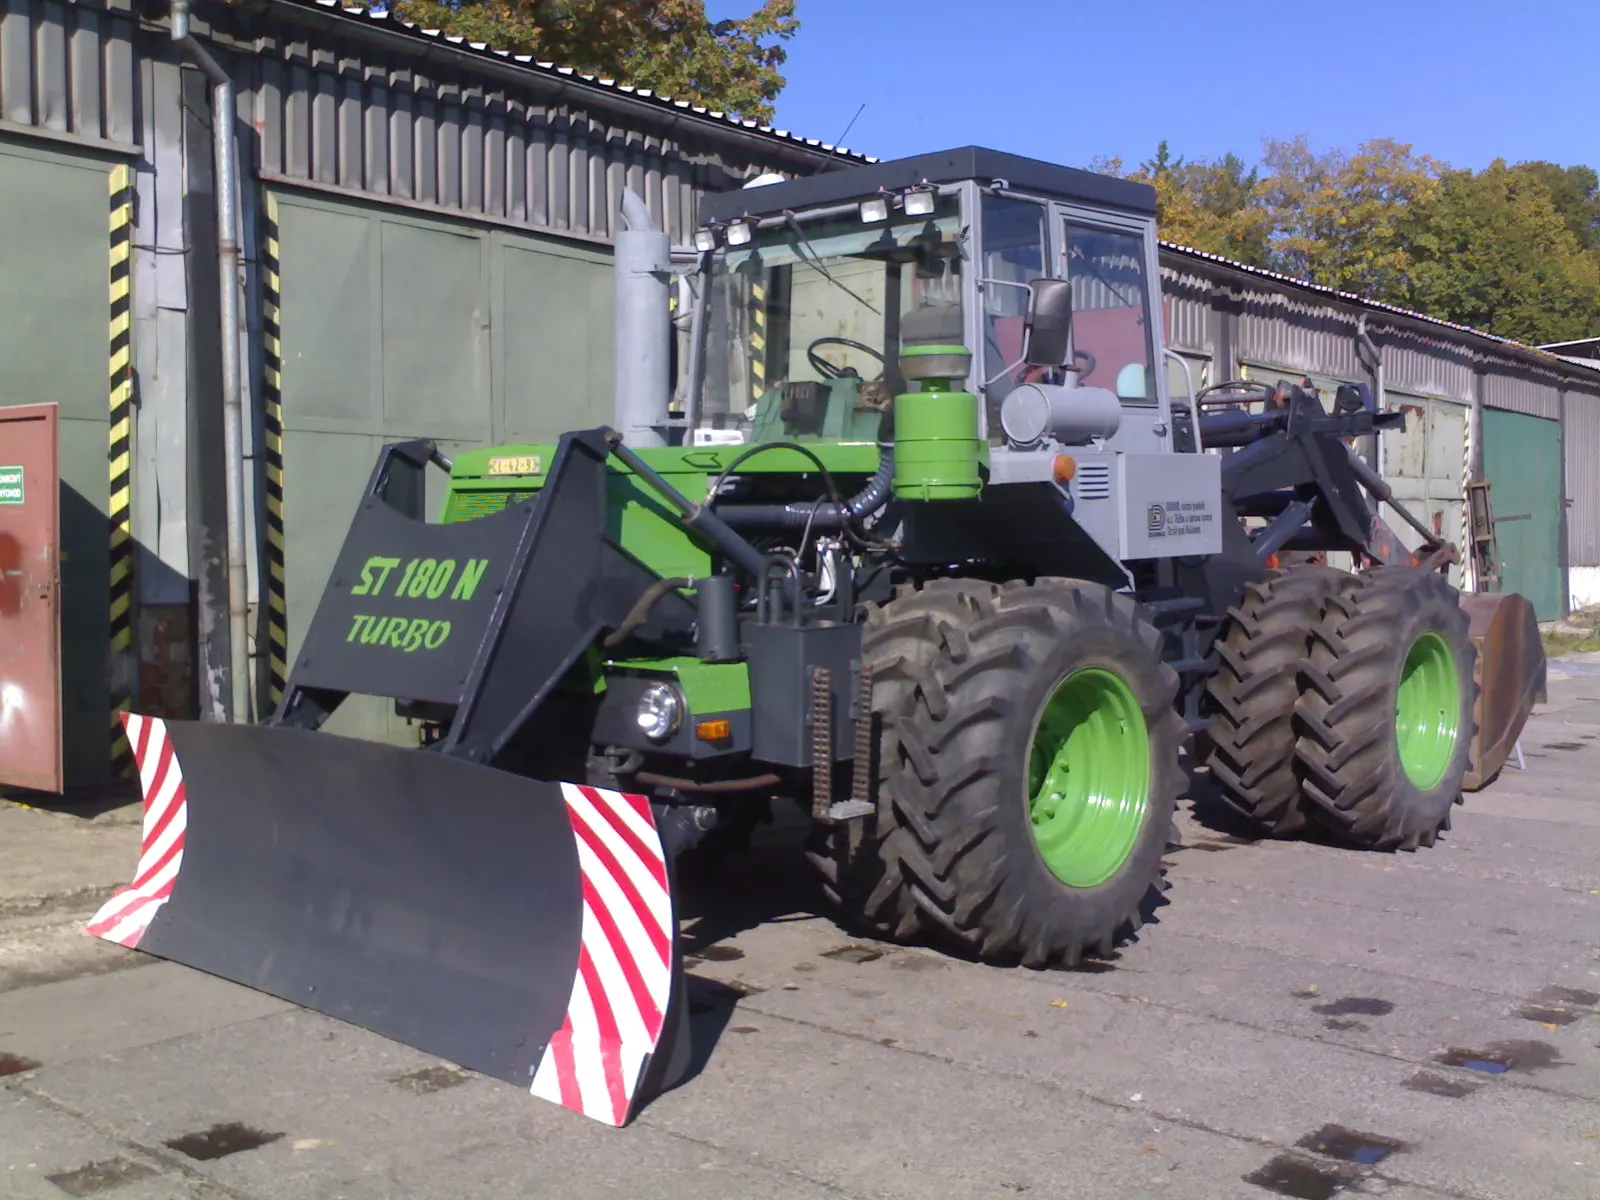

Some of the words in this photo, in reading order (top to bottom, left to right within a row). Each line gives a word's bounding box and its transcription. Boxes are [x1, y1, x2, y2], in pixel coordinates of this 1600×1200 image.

[350, 555, 401, 596] ST
[394, 558, 456, 600] 180
[450, 558, 489, 600] N
[345, 614, 451, 652] TURBO
